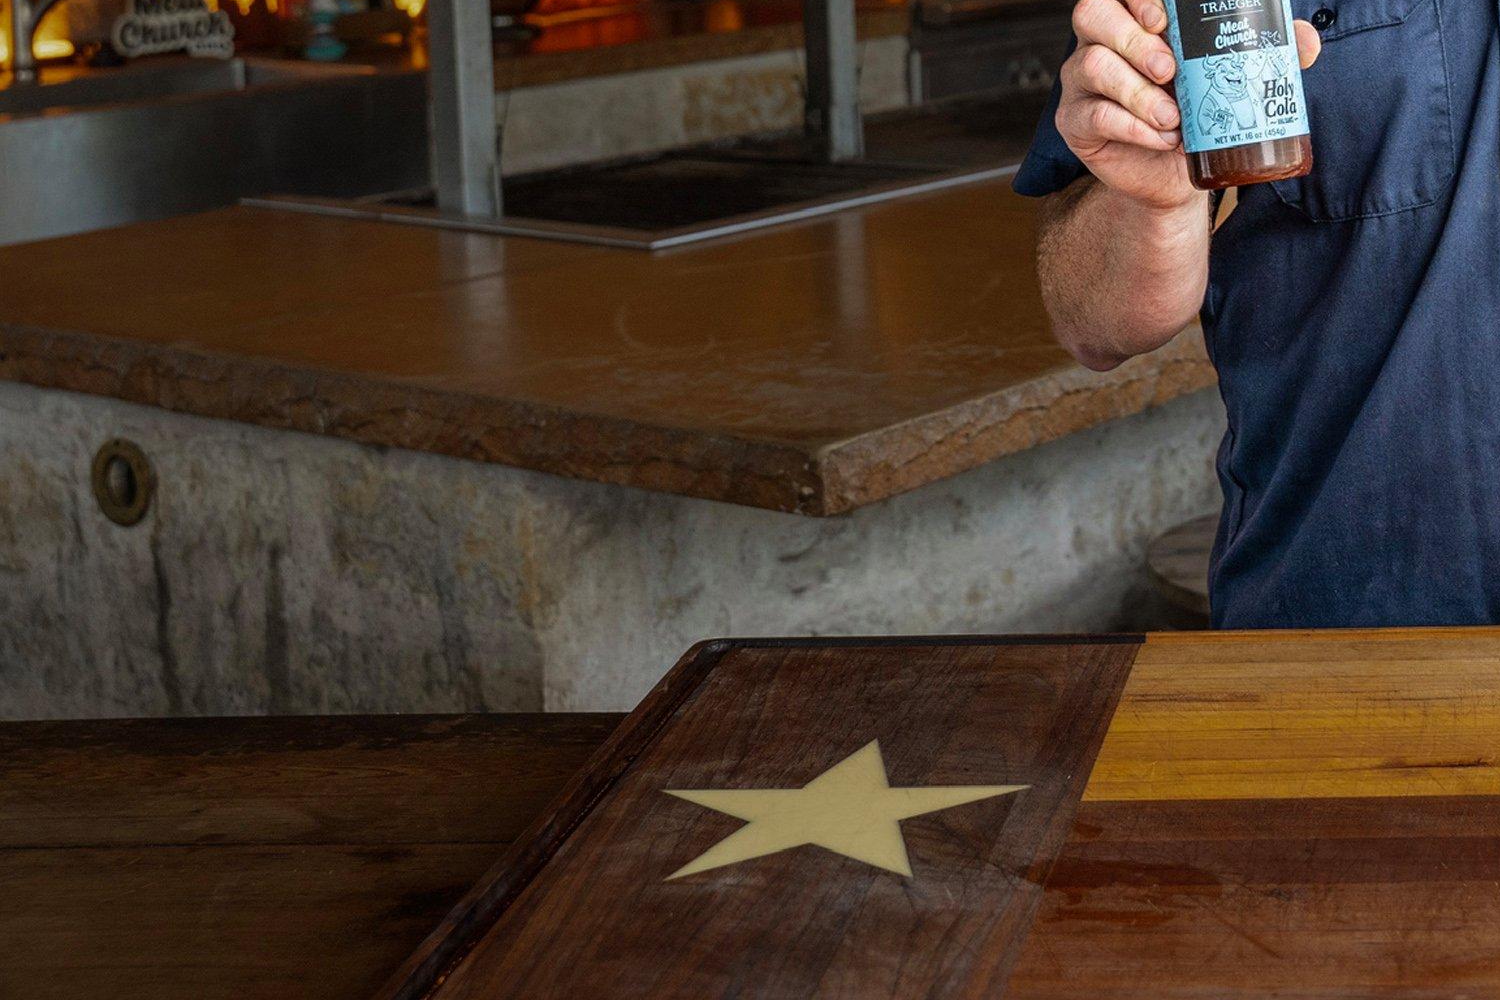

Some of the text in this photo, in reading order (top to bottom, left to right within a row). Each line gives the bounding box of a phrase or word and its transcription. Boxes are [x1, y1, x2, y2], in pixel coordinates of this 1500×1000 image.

[1220, 17, 1249, 34] Meat
[1215, 28, 1257, 49] Church
[1263, 77, 1294, 100] Holy
[1265, 97, 1296, 117] Cola
[1214, 135, 1228, 144] NET
